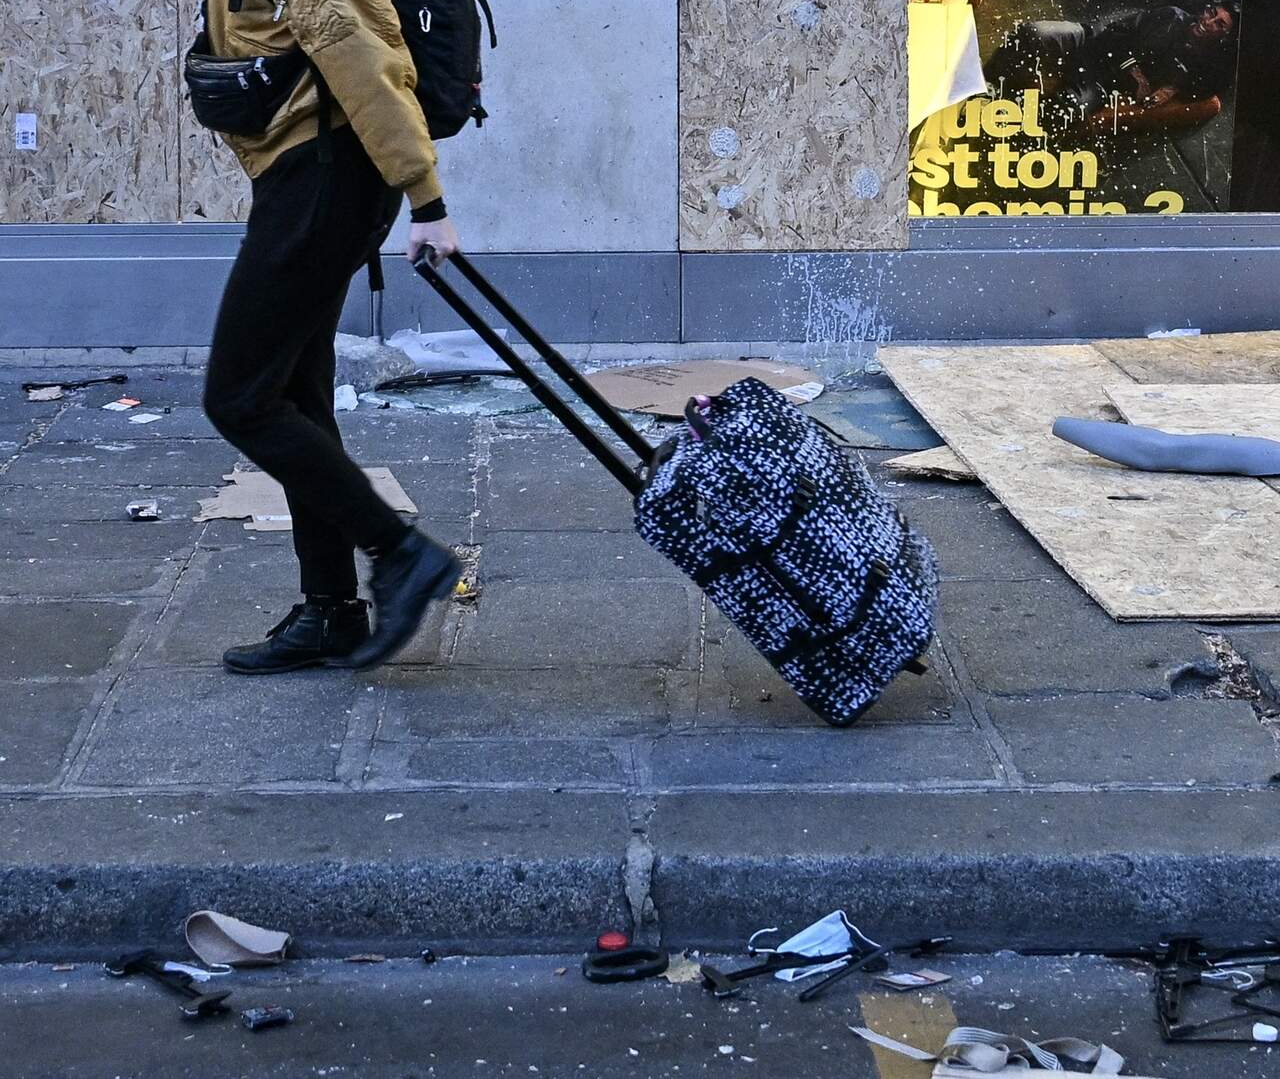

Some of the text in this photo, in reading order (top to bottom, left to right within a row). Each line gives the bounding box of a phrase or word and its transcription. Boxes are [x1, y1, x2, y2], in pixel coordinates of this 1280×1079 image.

[929, 88, 1043, 142] uel
[908, 143, 1098, 188] st ton
